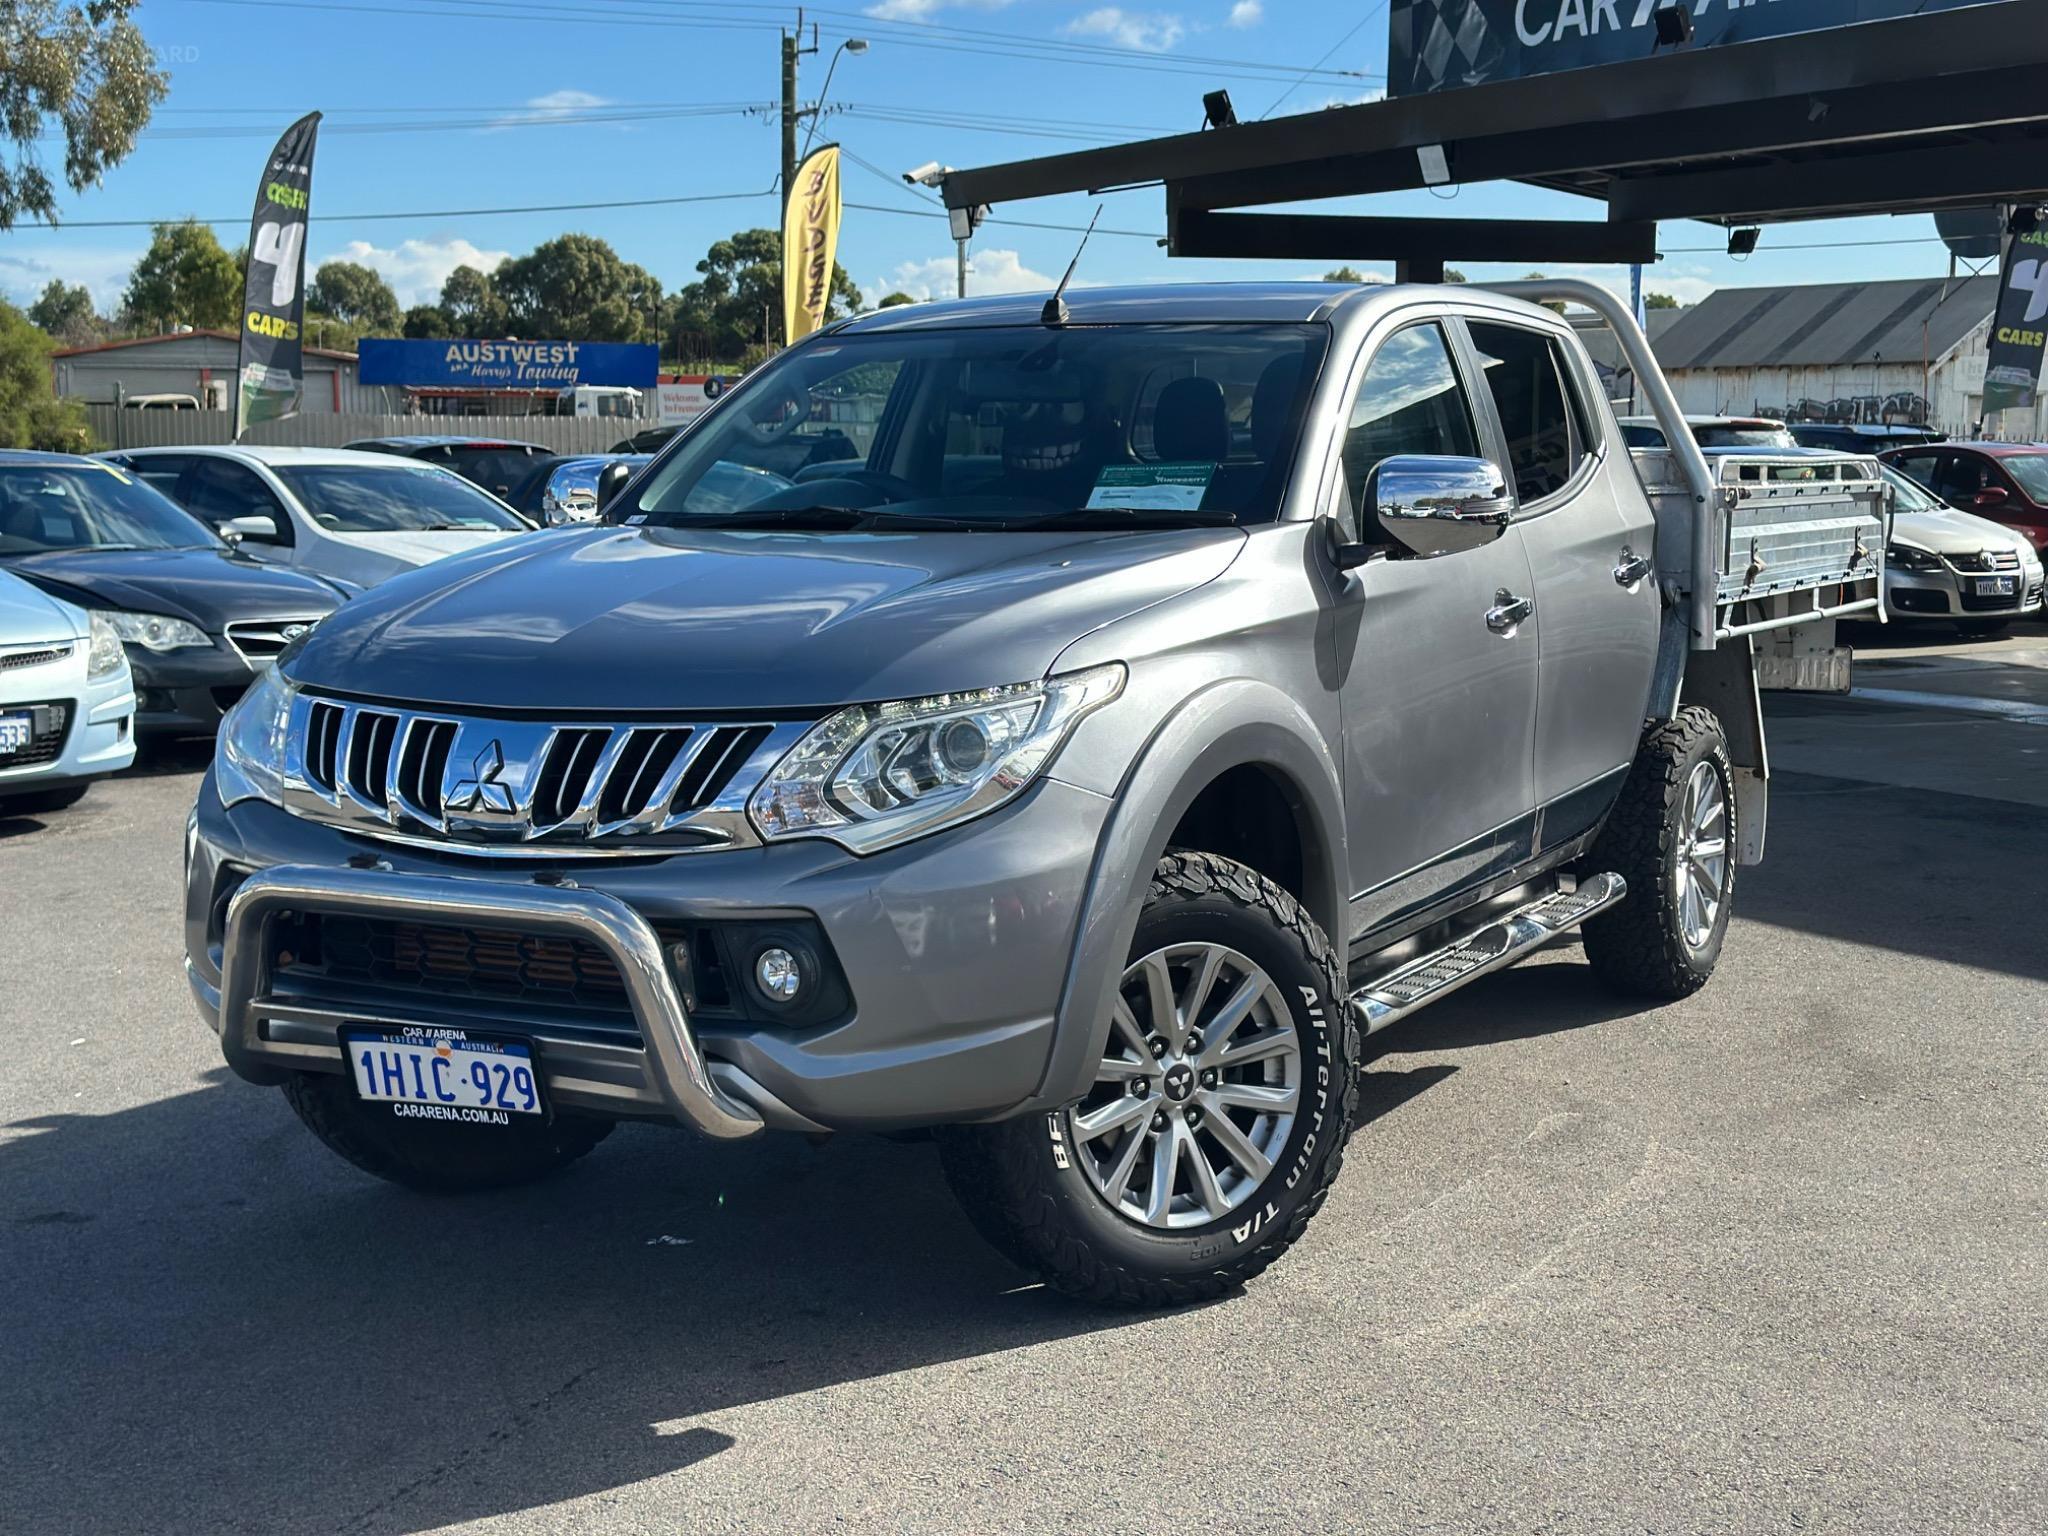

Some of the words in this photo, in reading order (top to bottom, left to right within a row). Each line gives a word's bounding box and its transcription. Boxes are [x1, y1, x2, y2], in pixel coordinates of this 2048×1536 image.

[253, 221, 305, 307] 4
[247, 312, 299, 340] CARS
[1998, 327, 2044, 347] CARS
[445, 343, 579, 363] AUSTWEST
[516, 361, 579, 382] Towing
[382, 1034, 425, 1046] WESTERN
[460, 1042, 504, 1054] AUSTRALIA
[402, 1026, 424, 1038] CAR
[433, 1029, 467, 1041] ARENA
[1286, 986, 1331, 1190] All-Terrain
[394, 1103, 509, 1125] CARARENA.COM.AU
[1232, 1202, 1280, 1244] T/A
